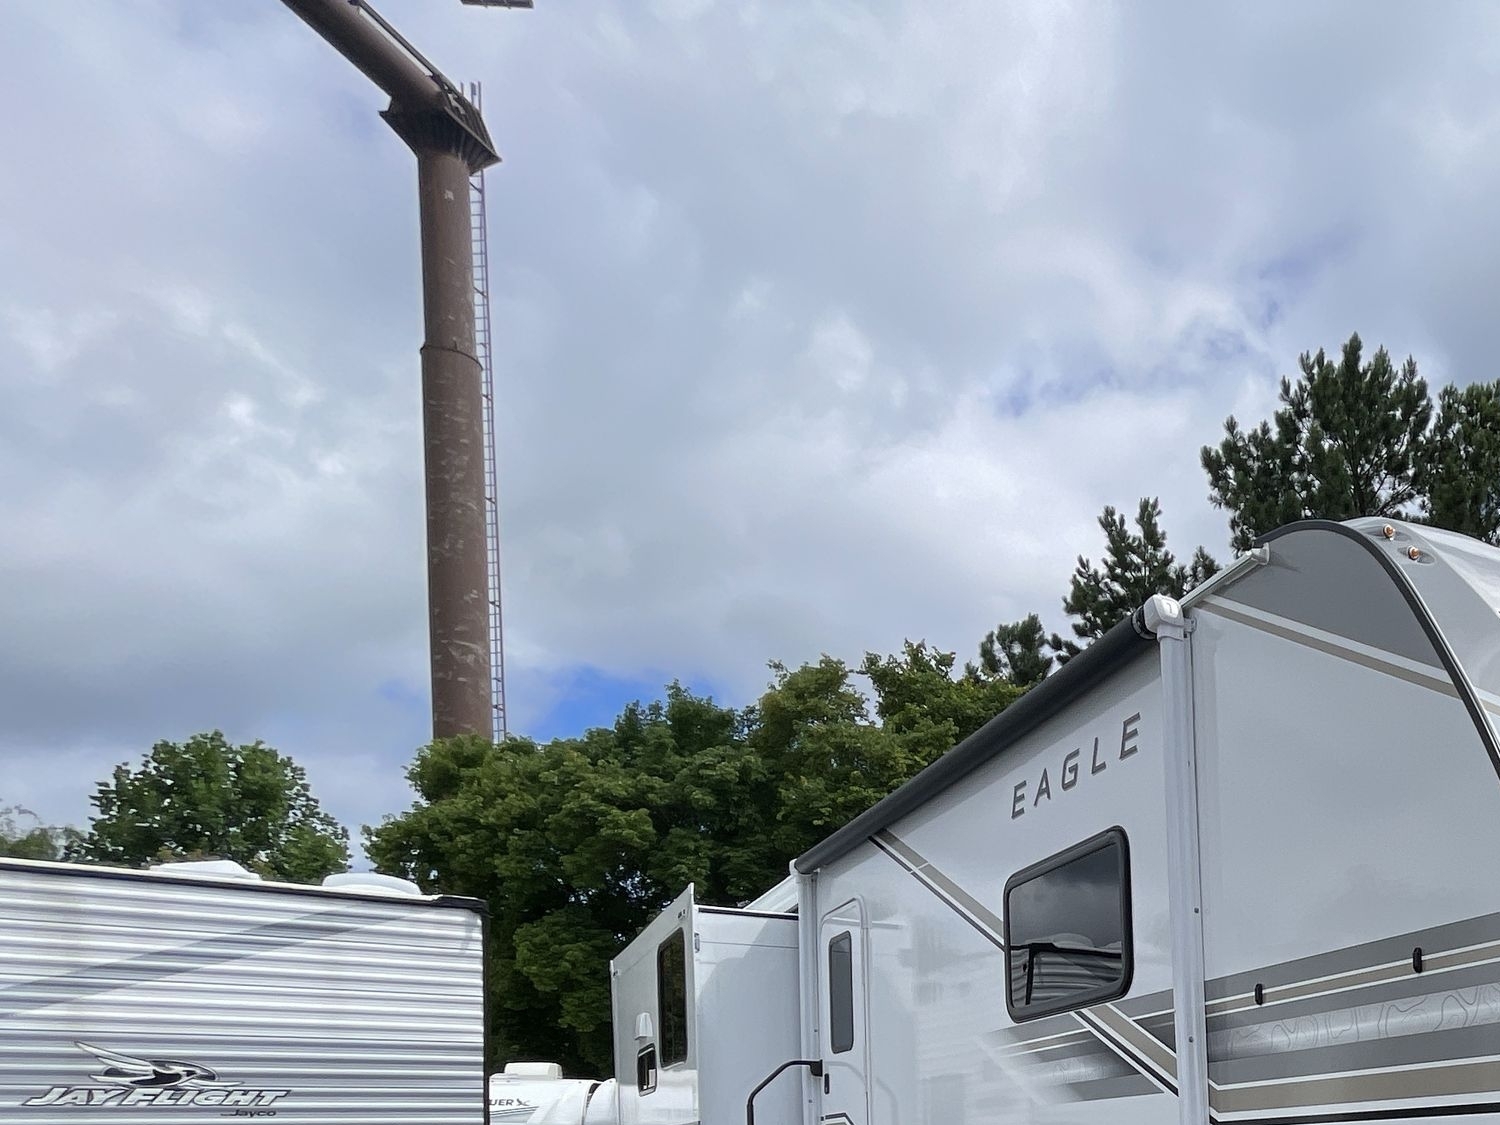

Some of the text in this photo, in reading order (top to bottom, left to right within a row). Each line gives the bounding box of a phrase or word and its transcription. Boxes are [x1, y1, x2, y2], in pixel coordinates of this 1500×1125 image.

[1011, 711, 1141, 820] EAGLE
[22, 1085, 291, 1107] JAY FLIGHT
[222, 1108, 277, 1118] Jayco
